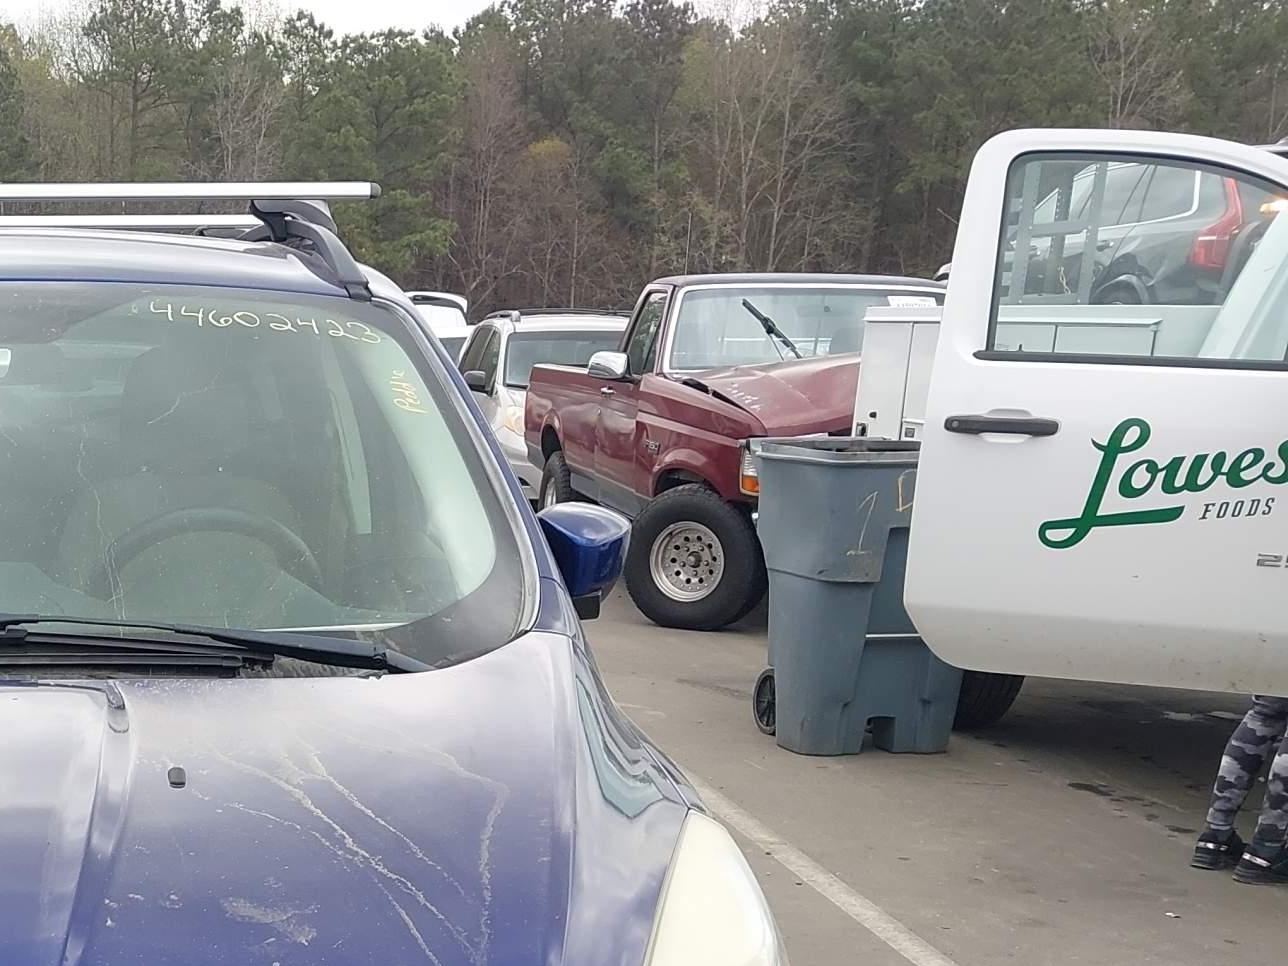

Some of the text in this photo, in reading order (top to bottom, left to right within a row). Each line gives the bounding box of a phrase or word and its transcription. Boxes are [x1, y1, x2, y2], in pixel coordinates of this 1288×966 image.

[149, 300, 382, 344] 44602423
[1038, 417, 1288, 549] Lowes
[1198, 497, 1276, 521] FOODS
